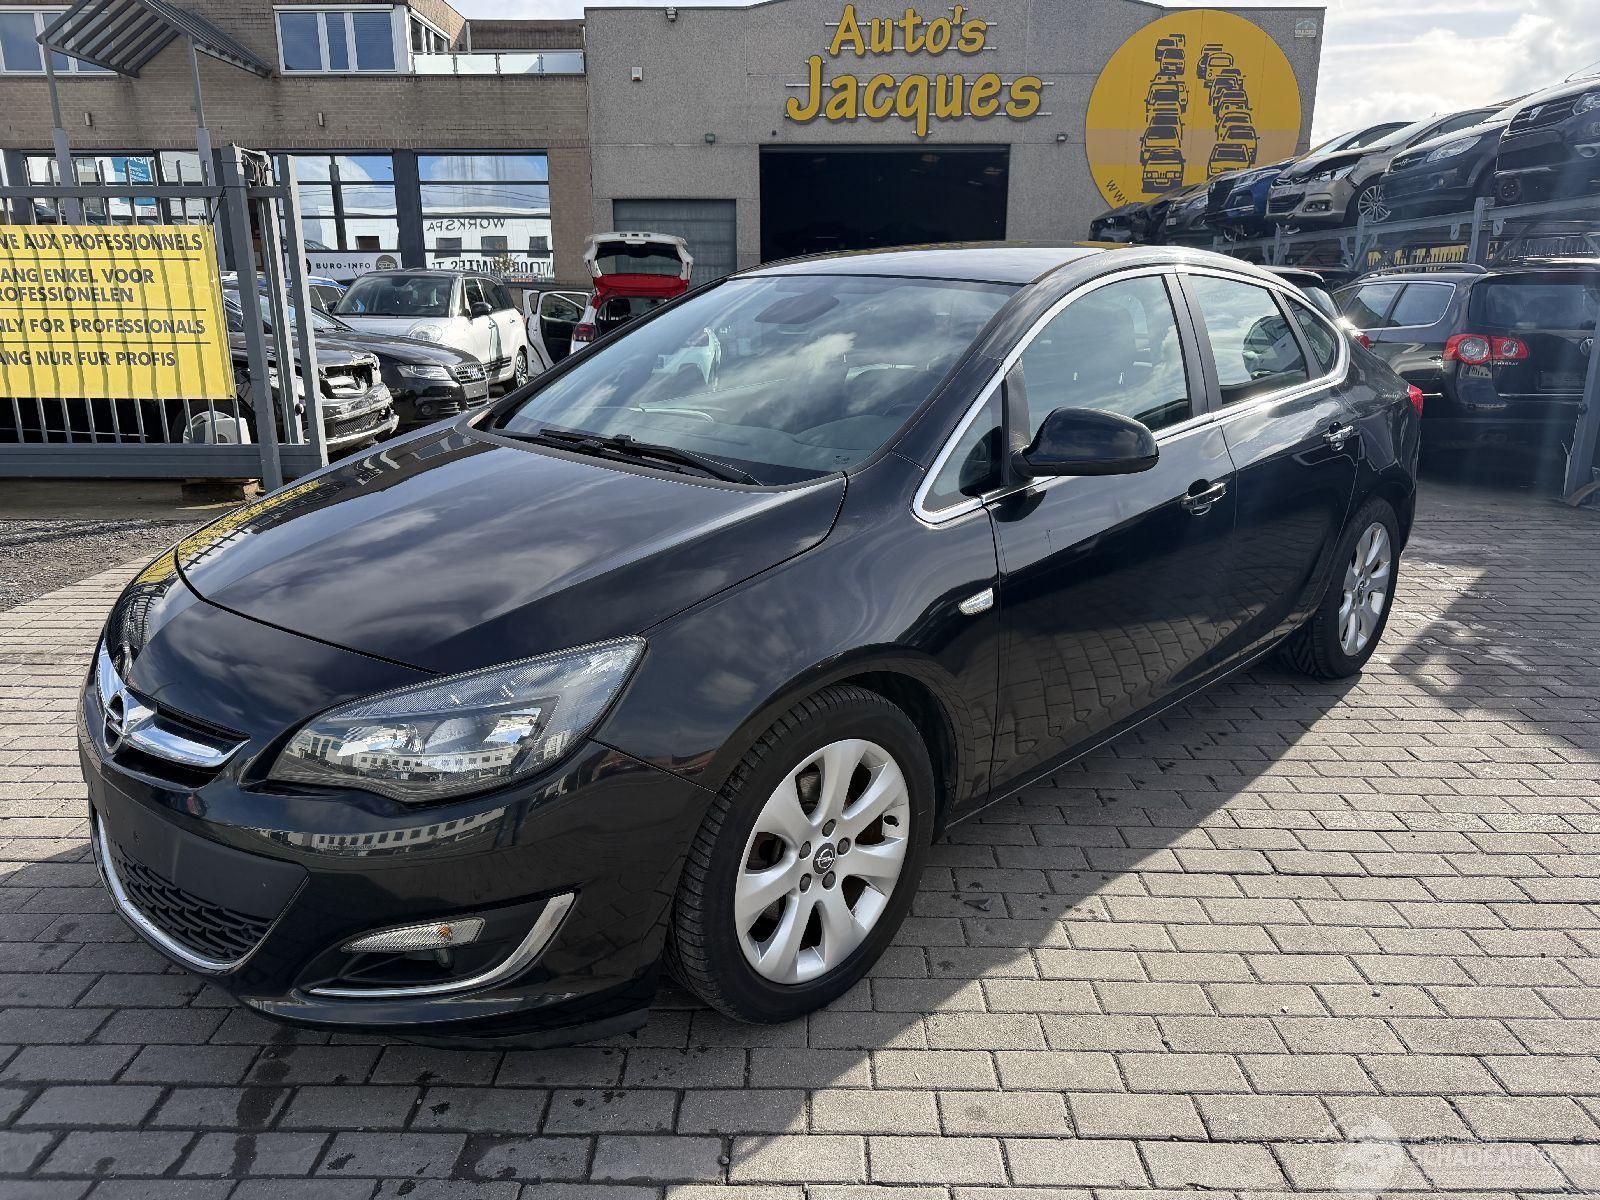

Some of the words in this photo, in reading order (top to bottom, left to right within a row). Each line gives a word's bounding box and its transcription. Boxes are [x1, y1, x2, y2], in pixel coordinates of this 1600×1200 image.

[829, 4, 987, 55] Auto's
[786, 55, 1042, 136] Jacques
[24, 234, 61, 249] AUX
[61, 233, 203, 250] PROFESSIONNELS
[0, 268, 38, 282] ANG
[44, 268, 98, 283] ENKEL
[101, 268, 155, 283] VOOR
[29, 318, 66, 332] FOR
[70, 318, 206, 334] PROFESSIONALS
[36, 351, 73, 365] NUR
[78, 352, 109, 366] FUR
[116, 352, 176, 366] PROFIS
